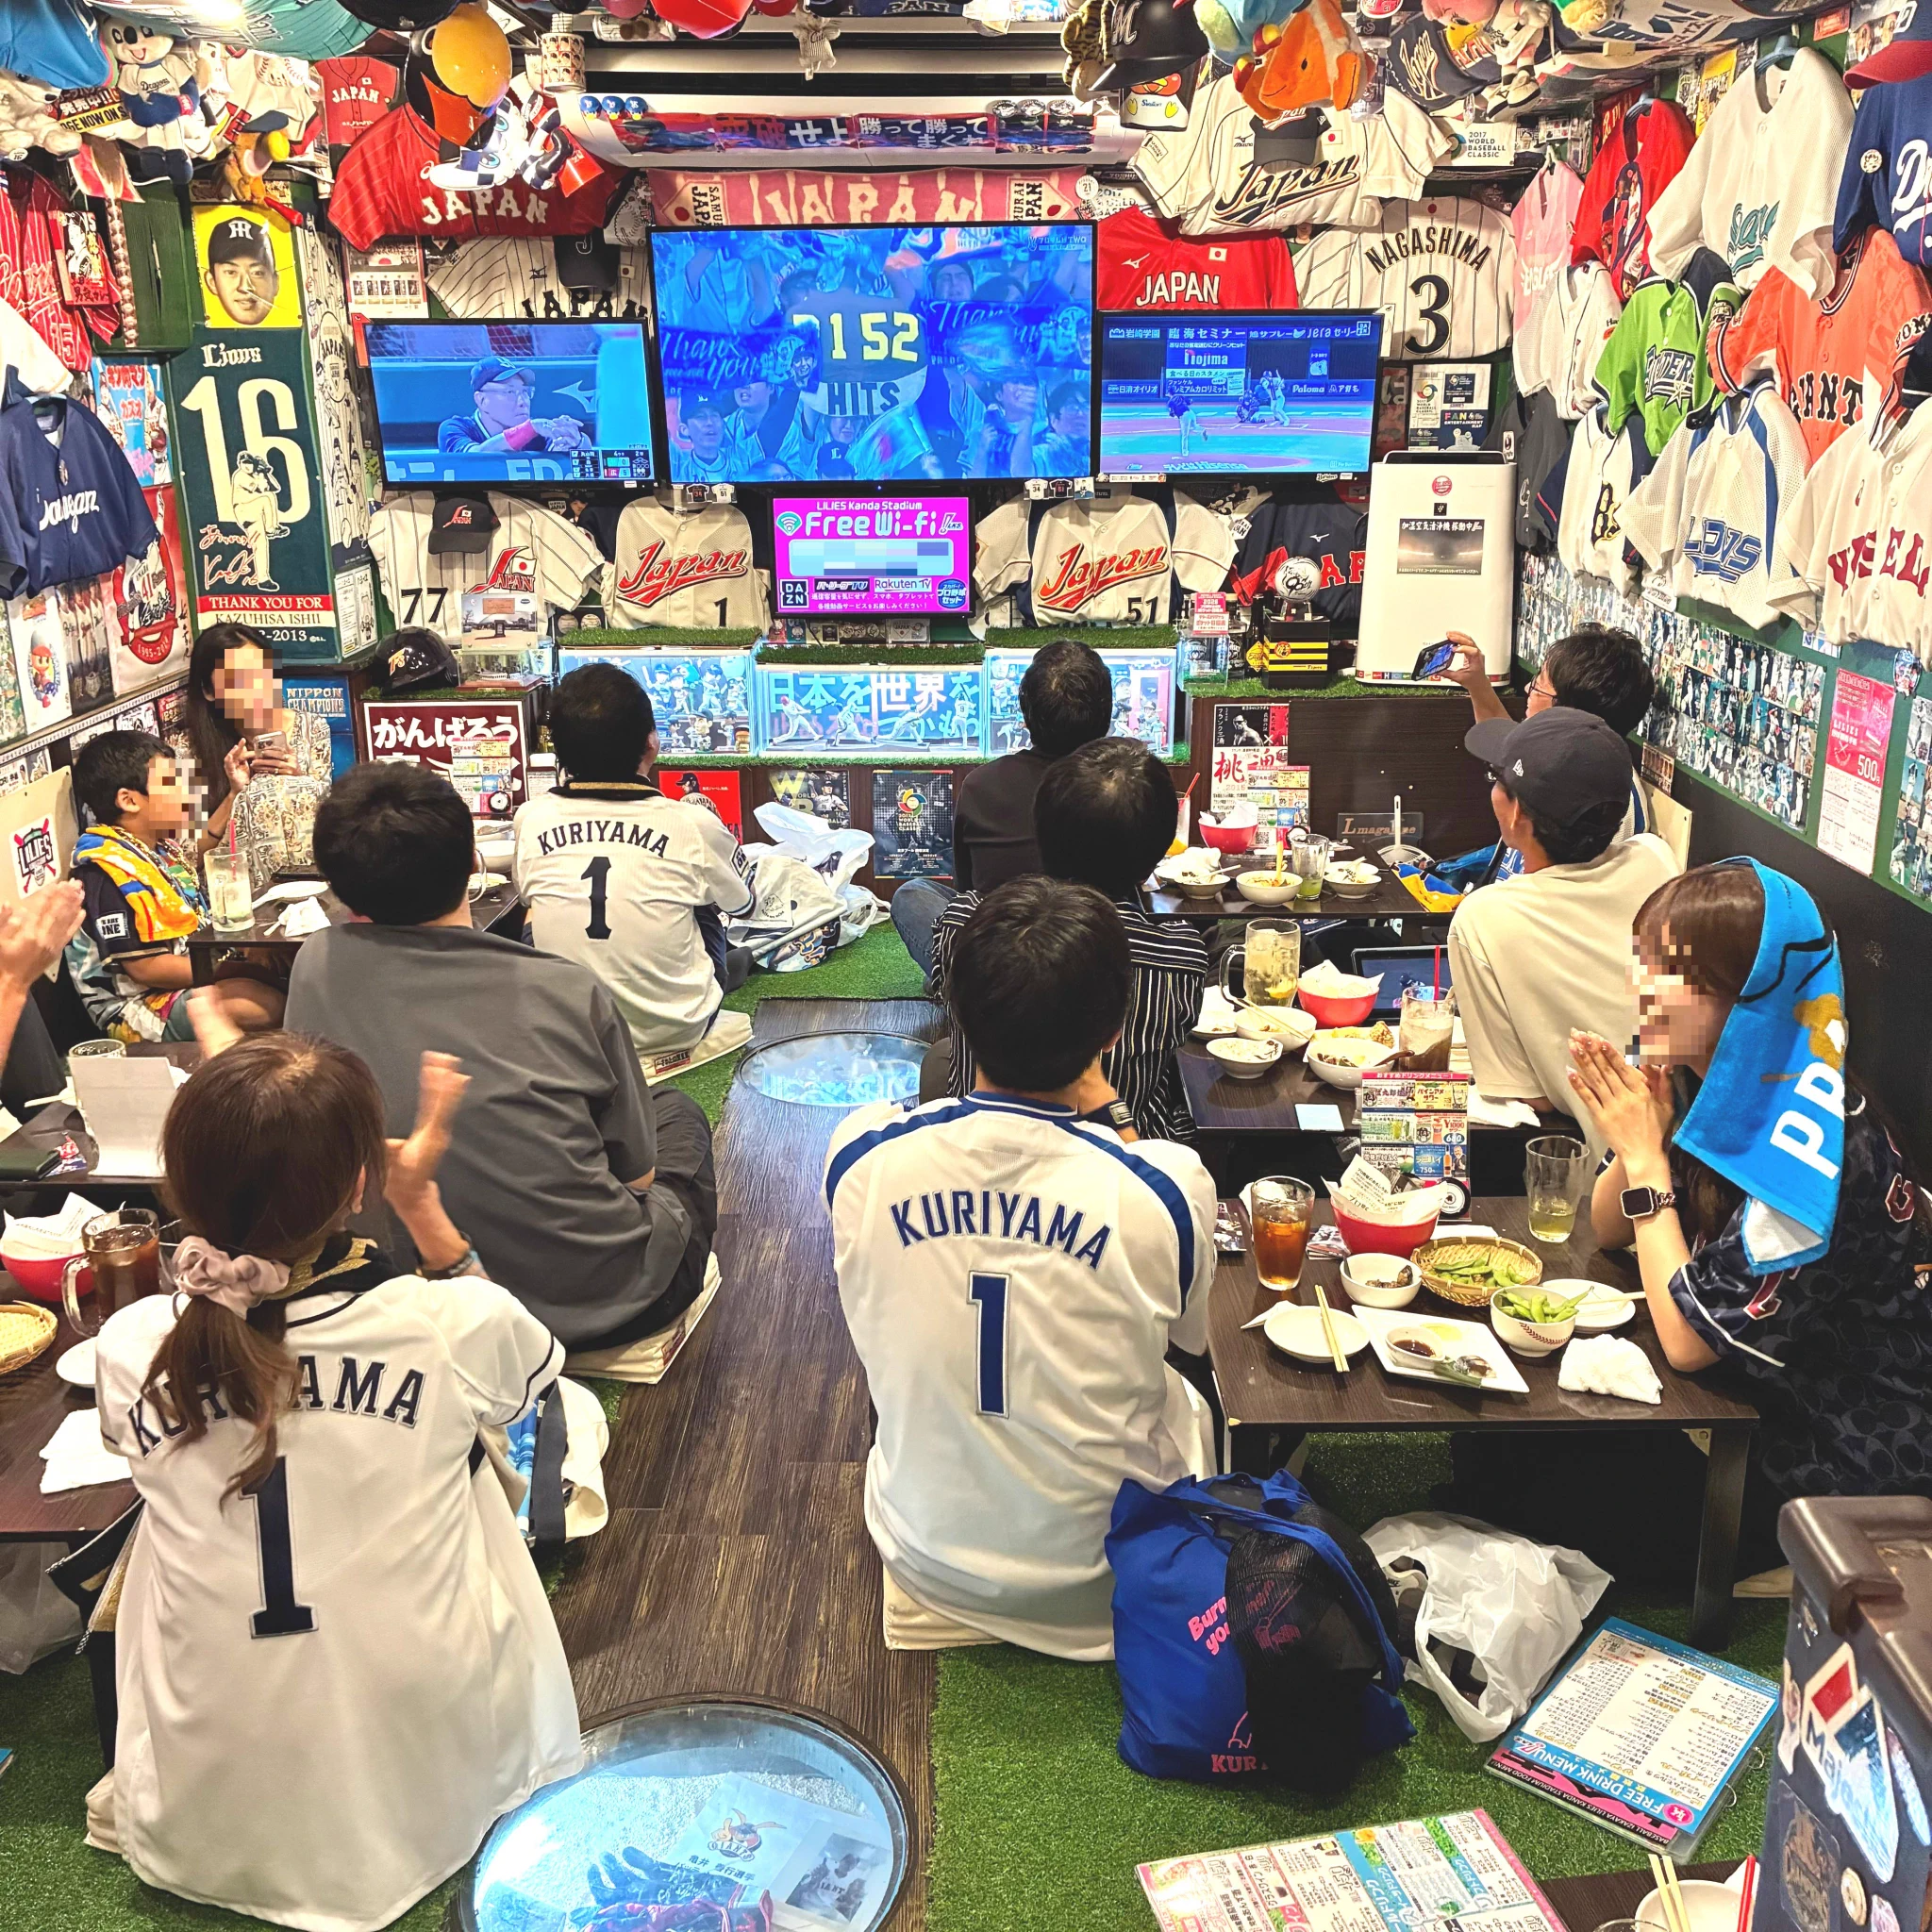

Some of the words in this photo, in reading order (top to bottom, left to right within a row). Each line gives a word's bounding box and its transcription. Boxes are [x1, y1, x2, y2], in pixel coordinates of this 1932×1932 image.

[332, 89, 379, 104] JAPAN
[80, 113, 105, 129] NOW
[104, 108, 120, 123] ON
[859, 117, 988, 134] 勝って勝って
[1213, 154, 1360, 223] Japan
[422, 189, 549, 225] JAPAN
[1365, 226, 1491, 275] NAGASHIMA
[1135, 272, 1219, 307] JAPAN
[1408, 275, 1453, 356] 3
[201, 342, 262, 368] Lions
[827, 382, 902, 415] HITS
[1119, 385, 1158, 393] 日清オイリオ
[1170, 385, 1226, 393] レミアムカロリミット
[1292, 384, 1324, 392] Paloma
[180, 375, 311, 525] 16
[817, 501, 846, 510] LILIES
[848, 501, 880, 510] Kanda
[882, 501, 923, 510] Stadium
[805, 511, 870, 537] Free
[874, 510, 937, 537] Wi-fi
[616, 539, 748, 604] Japan
[1039, 542, 1169, 612] Japan
[785, 583, 803, 593] DA
[875, 579, 917, 591] Rakuten
[937, 588, 966, 597] プロ野球
[209, 596, 260, 608] THANK
[263, 597, 292, 608] YOU
[296, 597, 323, 608] FOR
[401, 588, 448, 624] 77
[714, 597, 728, 627] 1
[786, 594, 803, 605] ZN
[941, 595, 963, 605] セット
[1127, 597, 1158, 625] 51
[215, 613, 284, 625] KAZUHISA
[290, 613, 321, 624] ISHII
[286, 687, 343, 699] NIPPON
[373, 716, 519, 749] がんばろう
[538, 820, 669, 858] KURIYAMA
[1341, 818, 1416, 836] Lmagazne
[18, 834, 53, 874] LILIES
[581, 857, 612, 940] 1
[889, 1188, 1113, 1272] KURIYAMA
[966, 1270, 1012, 1420] 1
[126, 1354, 427, 1460] KURAMA
[240, 1455, 319, 1640] 1
[1534, 1748, 1578, 1774] MENU
[1512, 1769, 1533, 1785] FOOD
[1532, 1777, 1563, 1799] STADIUM
[1574, 1766, 1624, 1795] DRINK
[1562, 1791, 1588, 1809] KANDA
[1621, 1788, 1665, 1814] FREE
[1607, 1811, 1637, 1831] IZAKAYA
[709, 1842, 755, 1861] GIANTS
[1363, 1879, 1408, 1932] ールドリンク
